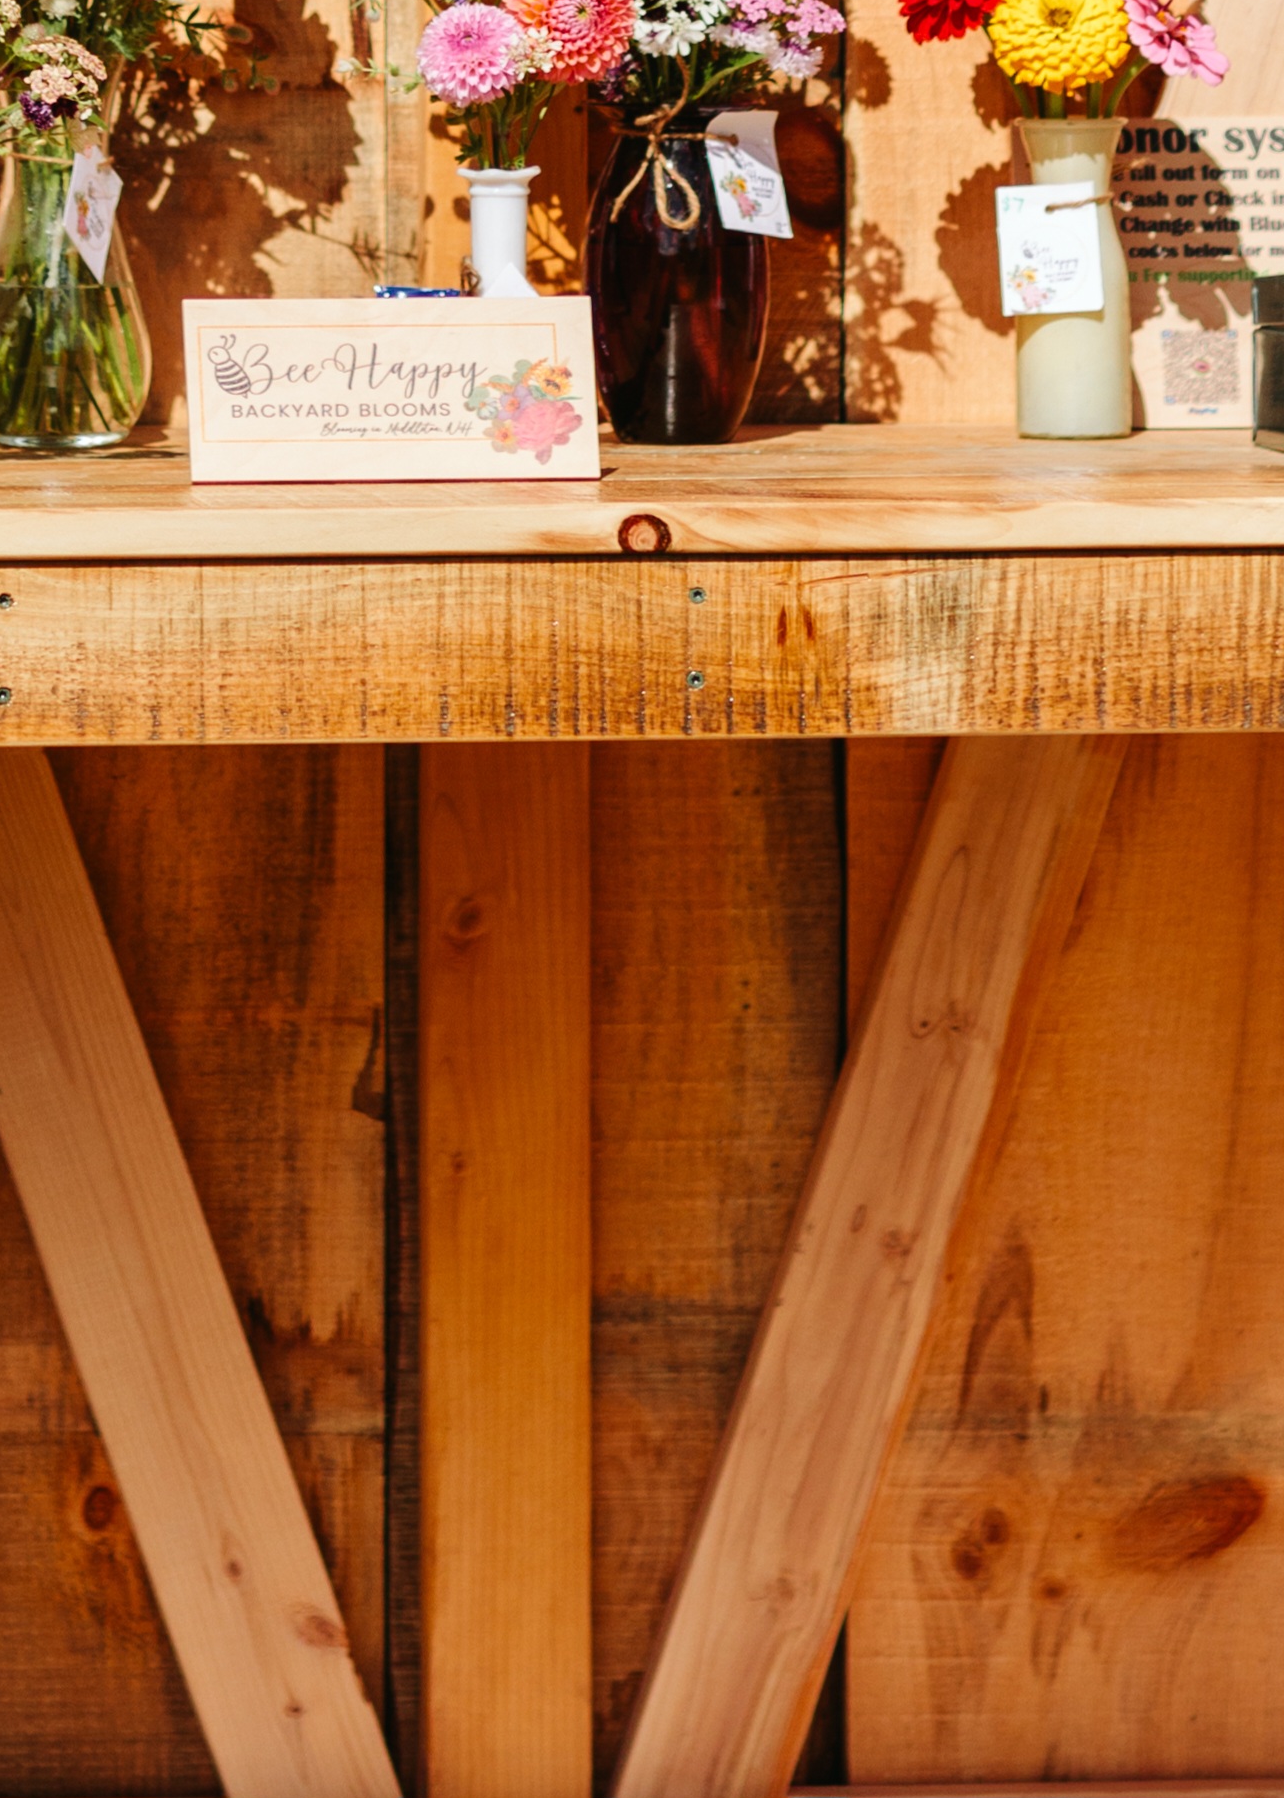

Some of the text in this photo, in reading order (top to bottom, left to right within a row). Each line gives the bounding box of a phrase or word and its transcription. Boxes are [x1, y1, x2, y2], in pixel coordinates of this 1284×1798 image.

[1116, 127, 1207, 153] onor
[1162, 166, 1195, 181] out
[1202, 165, 1248, 181] form
[1257, 168, 1280, 179] on
[1120, 191, 1169, 207] Cash
[1176, 194, 1198, 206] or
[1204, 190, 1264, 206] Check
[1120, 216, 1194, 236] Change
[1201, 216, 1240, 232] with
[1128, 245, 1178, 258] codes
[1184, 244, 1233, 257] below
[1238, 245, 1263, 257] for
[243, 342, 487, 399] Bee Happy
[232, 403, 451, 419] BACKYARD BLOOMS
[320, 422, 368, 437] Blooming
